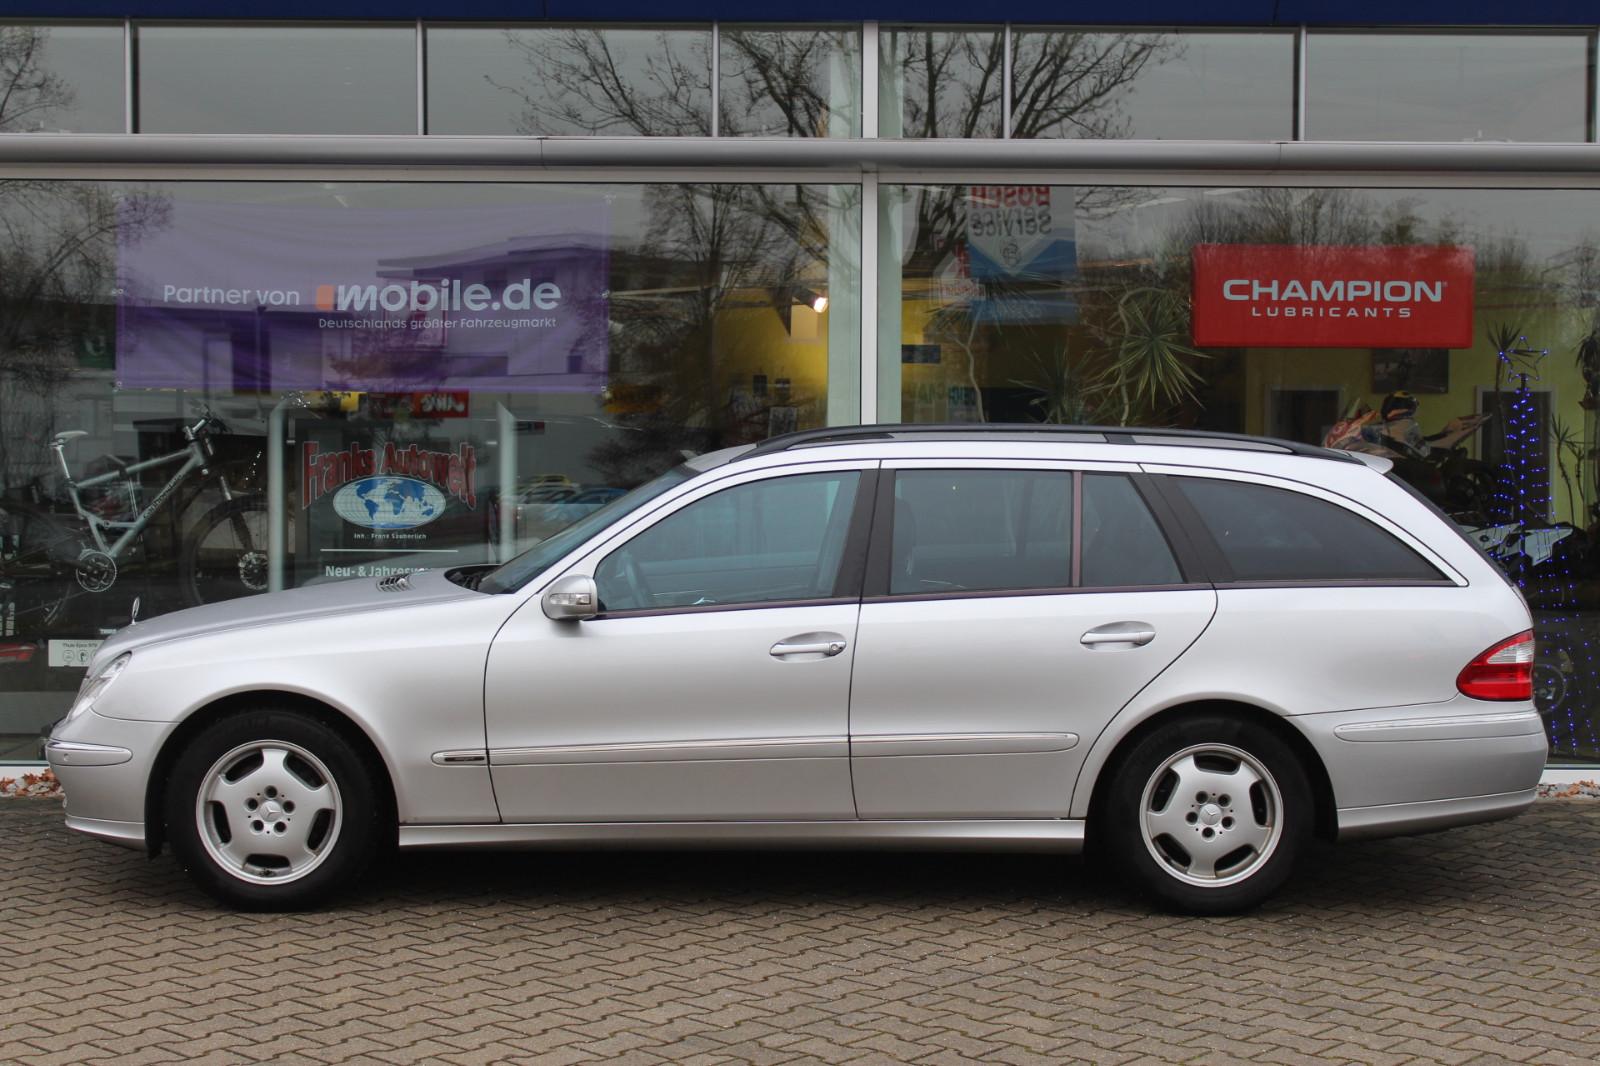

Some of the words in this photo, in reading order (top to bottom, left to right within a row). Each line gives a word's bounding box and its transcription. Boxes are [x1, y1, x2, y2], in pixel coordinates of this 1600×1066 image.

[163, 284, 253, 306] Partner
[256, 288, 300, 307] von
[336, 278, 561, 312] mobile.de
[1223, 279, 1442, 301] CHAMPION
[1252, 307, 1411, 318] LUBRICANTS
[318, 318, 407, 329] Deutschlands
[460, 317, 557, 331] Fahrzeugmarkt
[303, 442, 376, 509] Franks
[381, 442, 476, 509] Autowelt
[325, 565, 355, 577] Neu-
[358, 565, 366, 577] &
